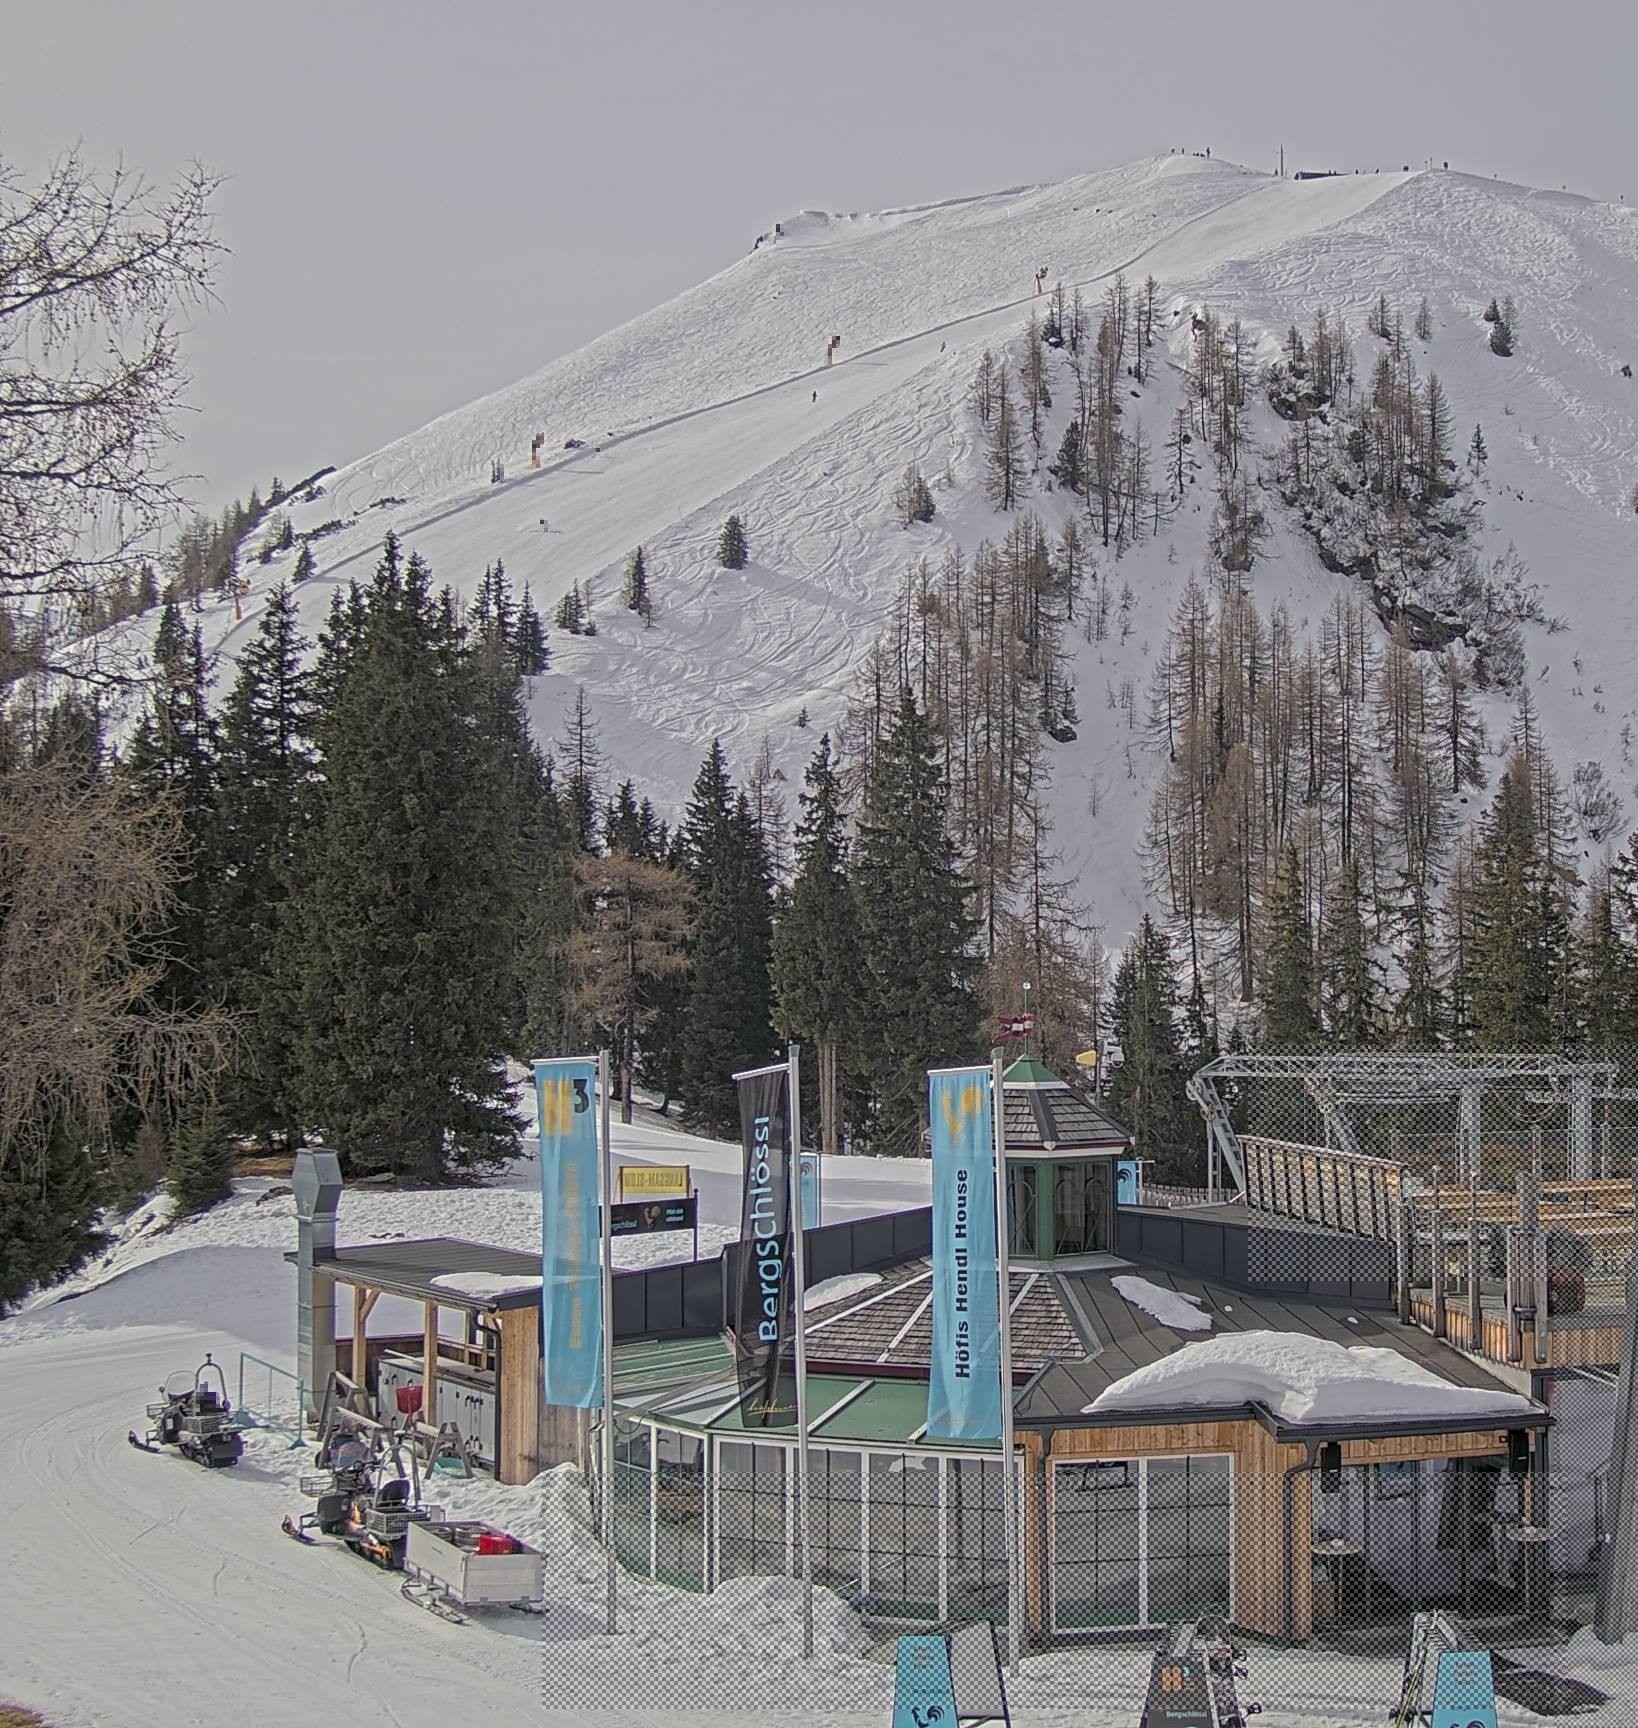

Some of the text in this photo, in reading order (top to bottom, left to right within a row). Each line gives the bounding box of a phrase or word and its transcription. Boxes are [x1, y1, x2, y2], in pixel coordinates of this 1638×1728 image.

[750, 1115, 782, 1342] Bergschlössl
[955, 1169, 970, 1379] Höfis Hendl House
